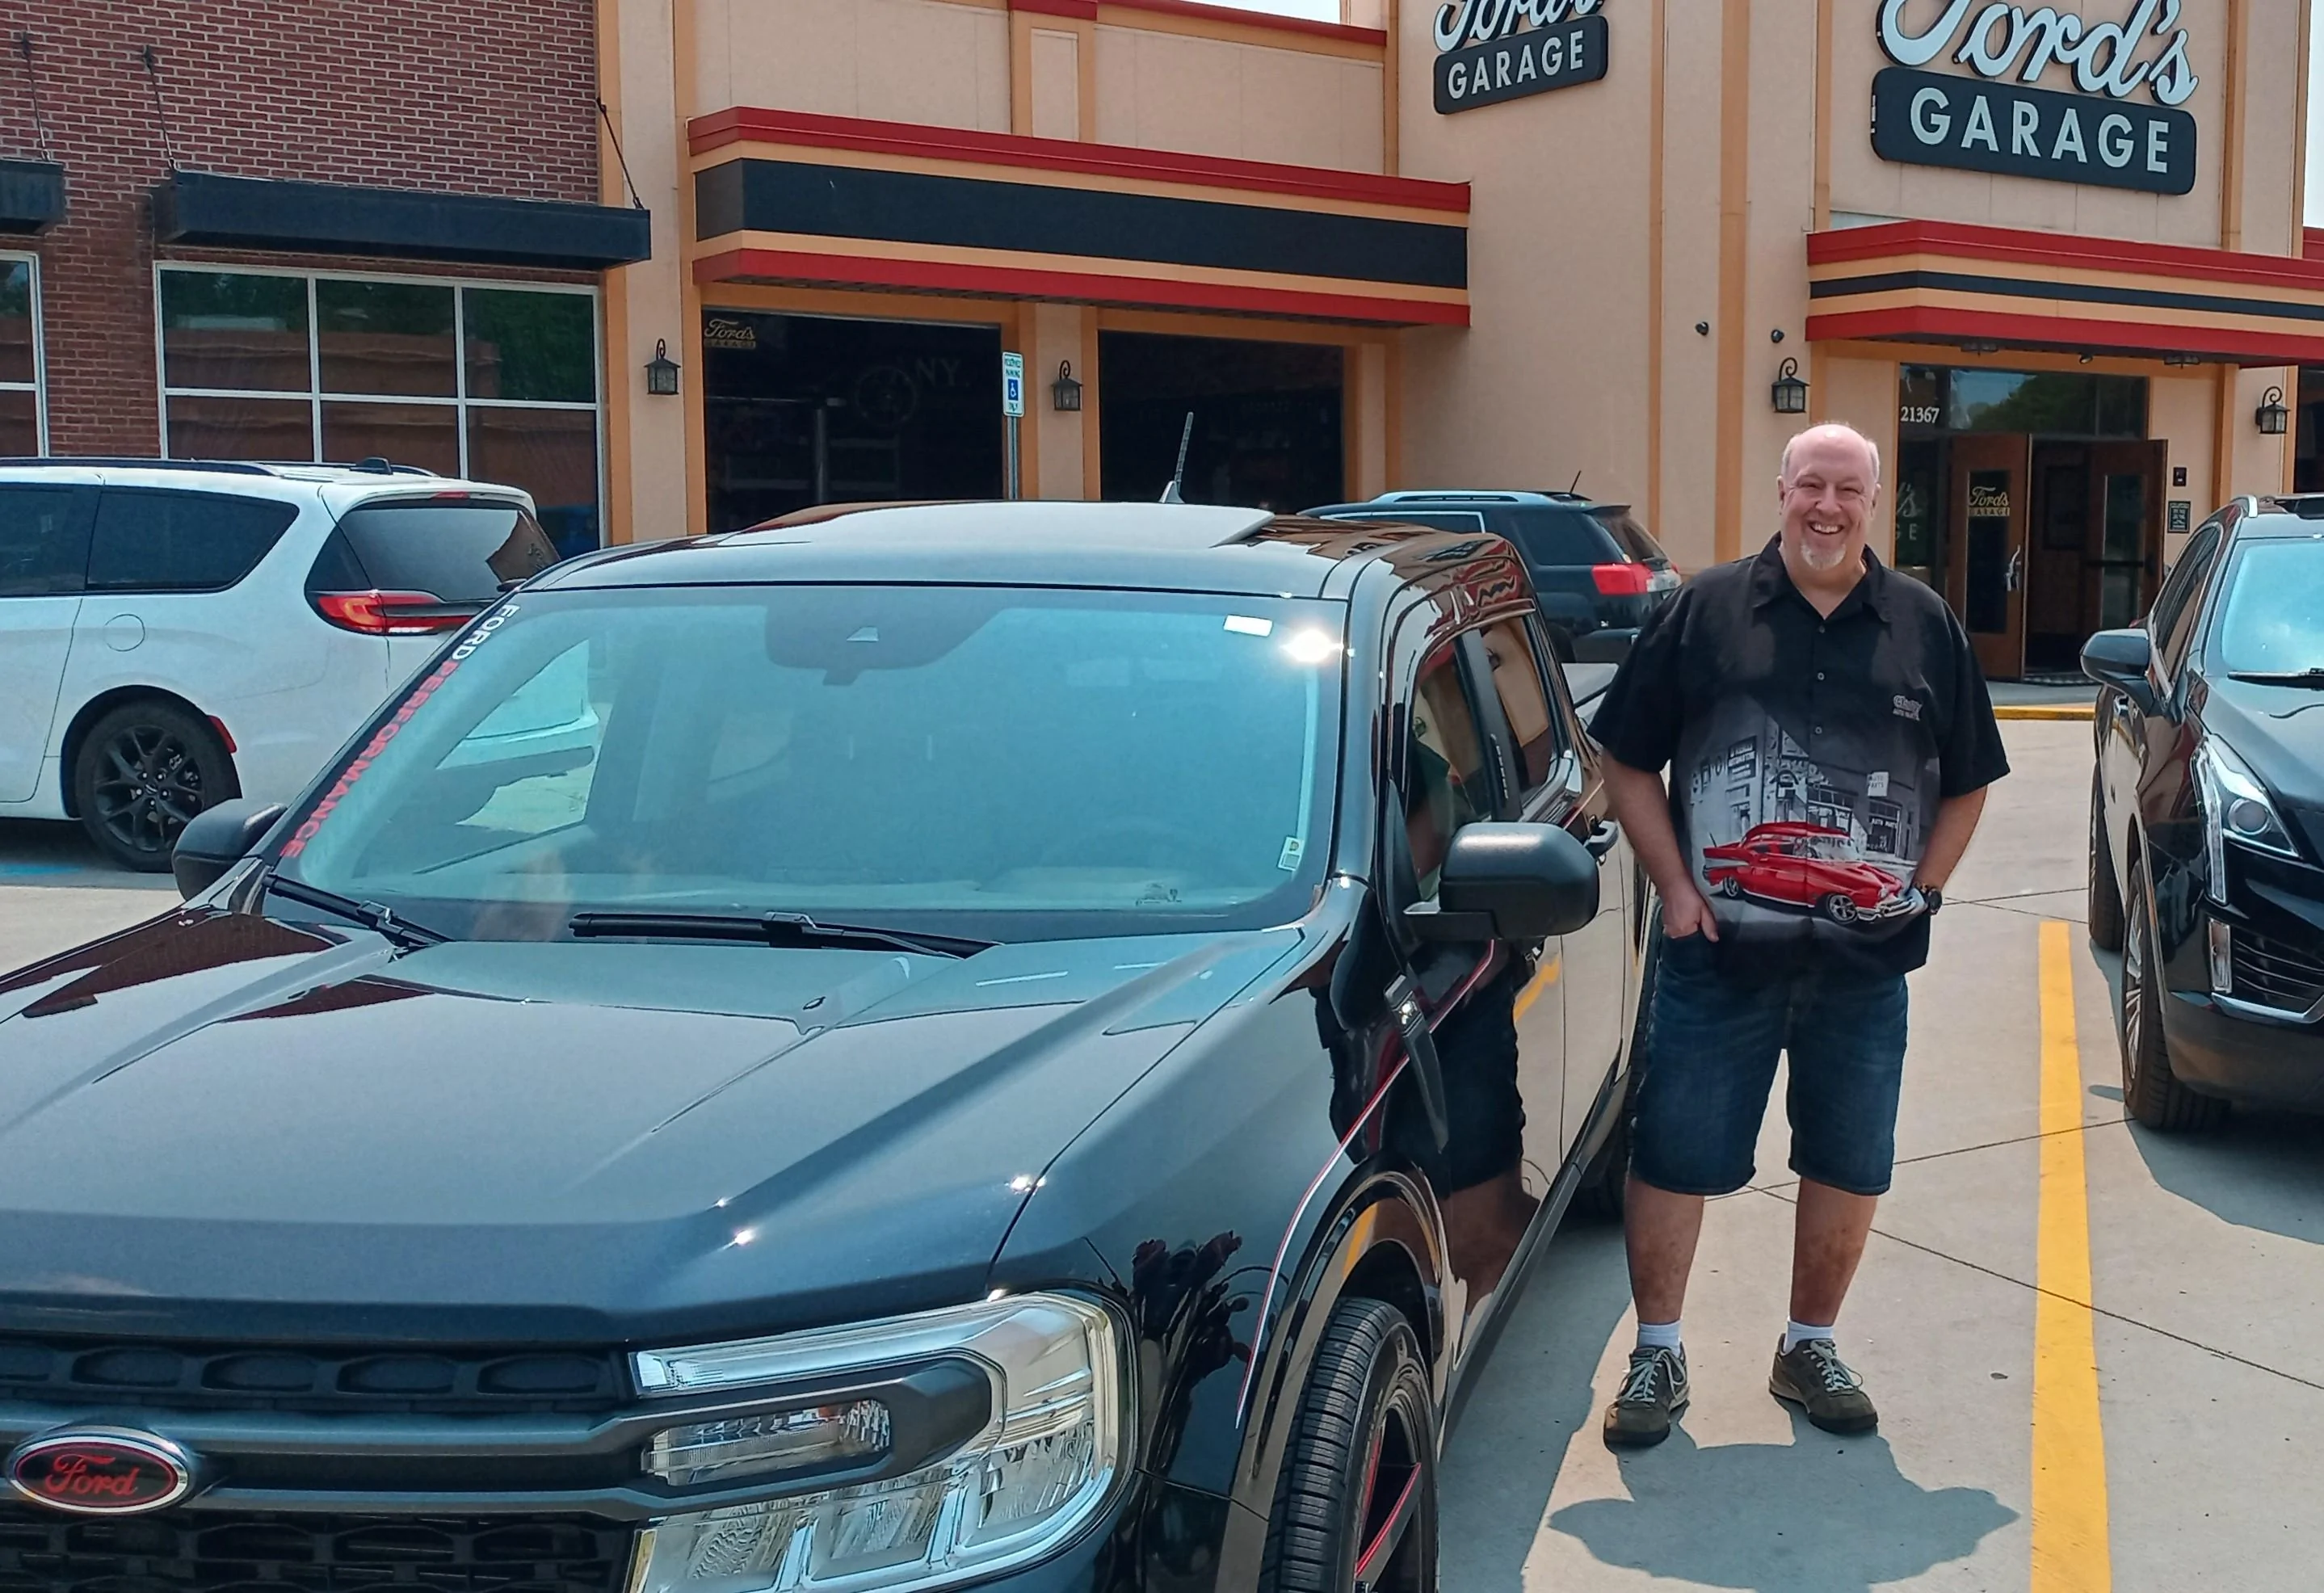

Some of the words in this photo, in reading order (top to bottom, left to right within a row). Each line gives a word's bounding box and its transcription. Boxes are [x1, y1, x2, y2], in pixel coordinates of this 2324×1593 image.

[1448, 30, 1584, 99] GARAGE
[1910, 87, 2170, 174] GARAGE
[704, 317, 755, 339] Ford's
[1900, 406, 1940, 424] 21367
[452, 604, 520, 660] FORD
[44, 1453, 140, 1495] Ford
